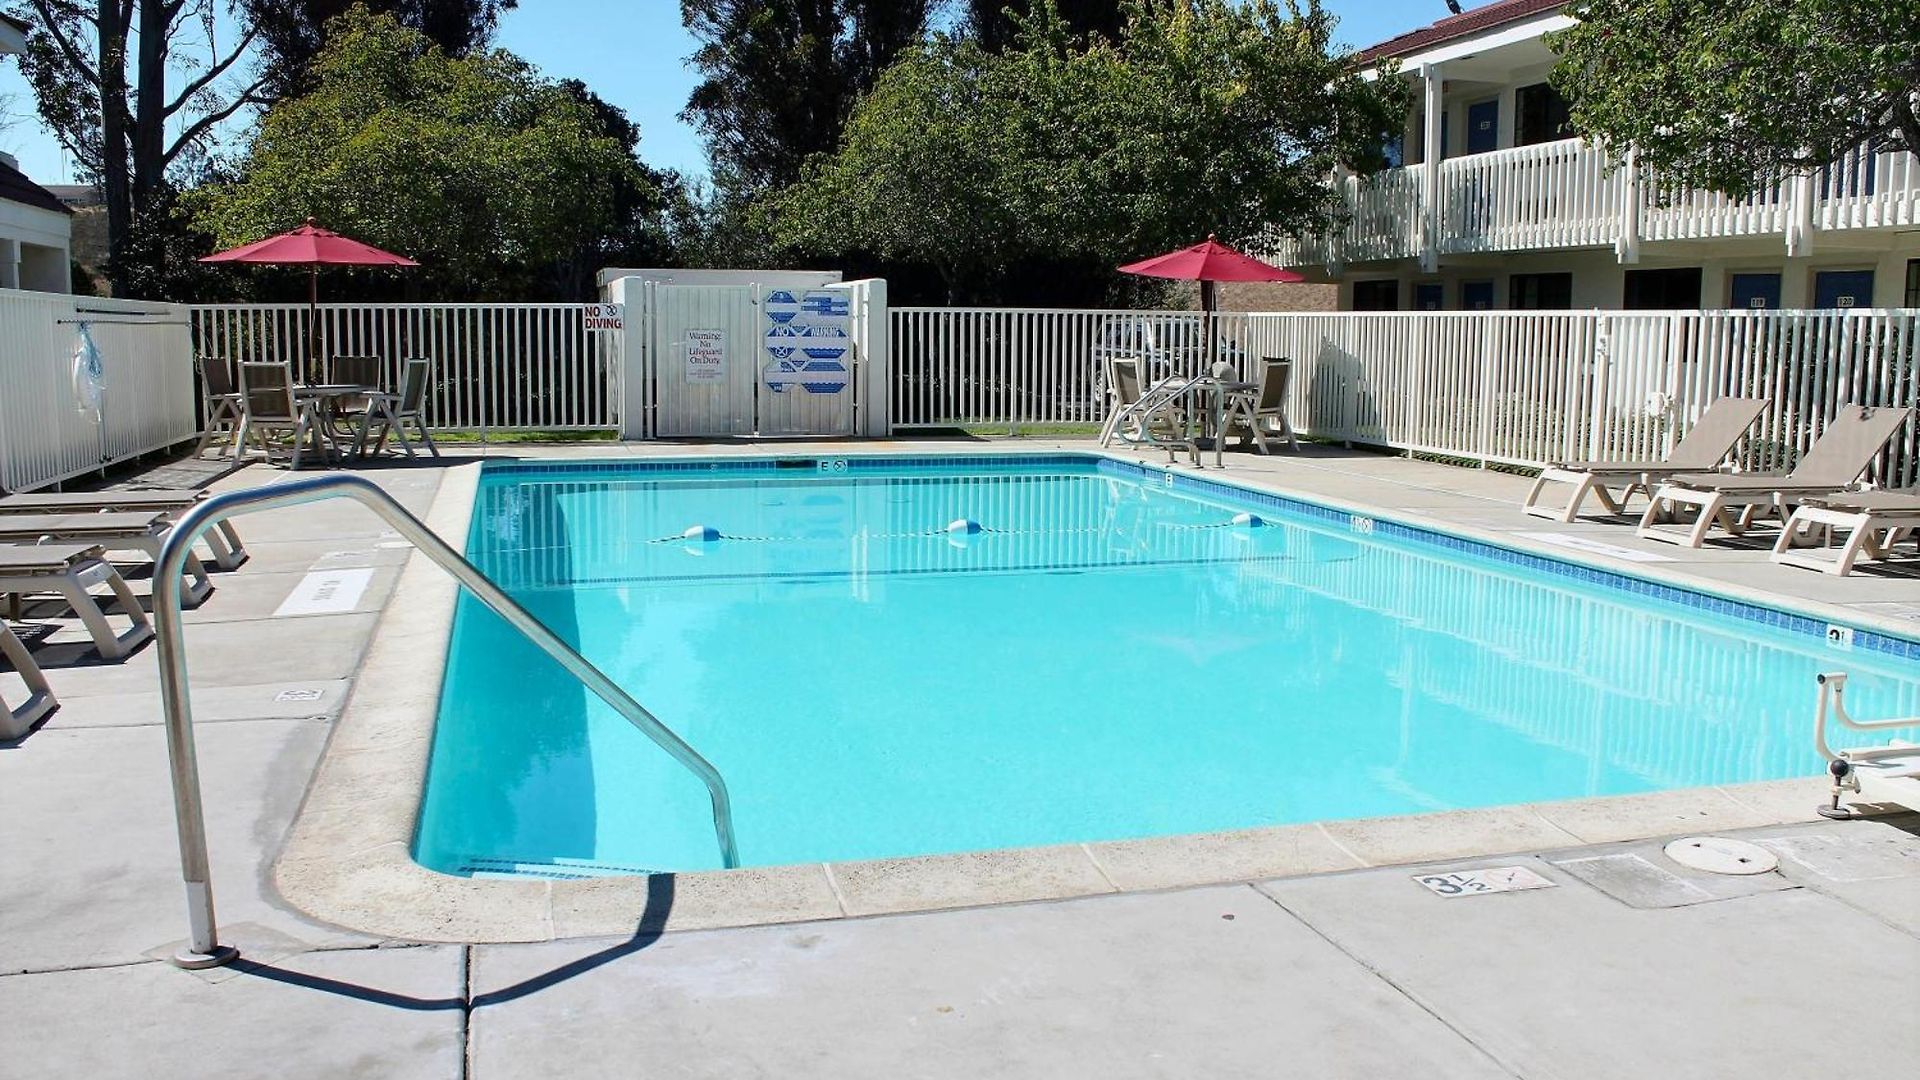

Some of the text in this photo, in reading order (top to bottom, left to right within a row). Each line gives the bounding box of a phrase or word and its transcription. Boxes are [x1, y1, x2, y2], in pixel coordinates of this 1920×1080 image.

[585, 306, 600, 317] NO
[585, 318, 622, 329] DIVING
[700, 340, 712, 348] No
[690, 348, 723, 357] Lifeguard
[690, 356, 720, 366] On Duty
